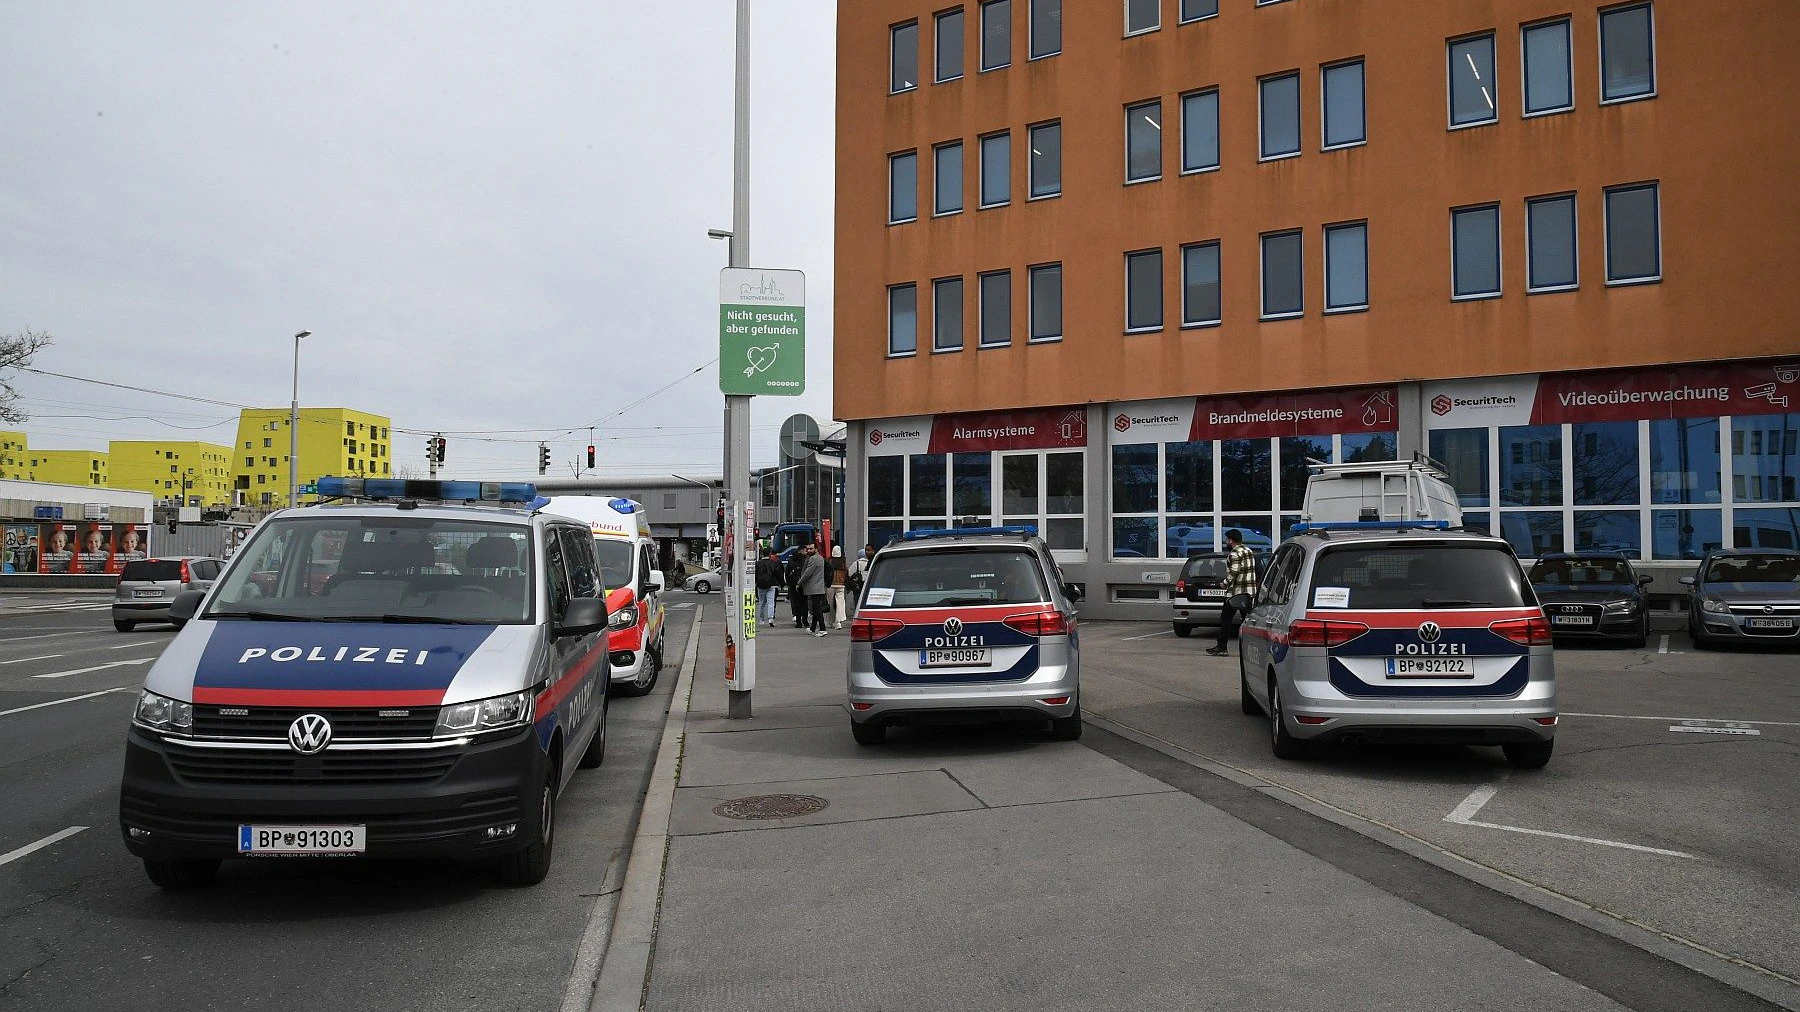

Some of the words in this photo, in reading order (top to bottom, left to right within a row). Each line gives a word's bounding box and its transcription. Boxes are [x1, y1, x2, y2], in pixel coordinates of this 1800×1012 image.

[727, 310, 753, 320] Nicht
[755, 311, 797, 324] gesucht,
[726, 323, 748, 333] aber
[751, 324, 798, 336] gefunden
[1454, 395, 1516, 407] SecuritTech
[1558, 384, 1730, 407] Videoüberwachung
[1131, 414, 1179, 425] SecuritTech
[1209, 407, 1343, 425] Brandmeldesysteme
[882, 430, 920, 440] SecuritTech
[952, 425, 1035, 441] Alarmsysteme
[925, 635, 984, 648] POLIZEI
[238, 646, 429, 666] POLIZEI
[1395, 643, 1466, 655] POLIZEI
[929, 650, 942, 664] BP
[951, 649, 985, 662] 90967
[1399, 660, 1415, 673] BP
[1425, 659, 1465, 673] 92122
[259, 830, 282, 848] BP
[297, 830, 354, 848] 91303
